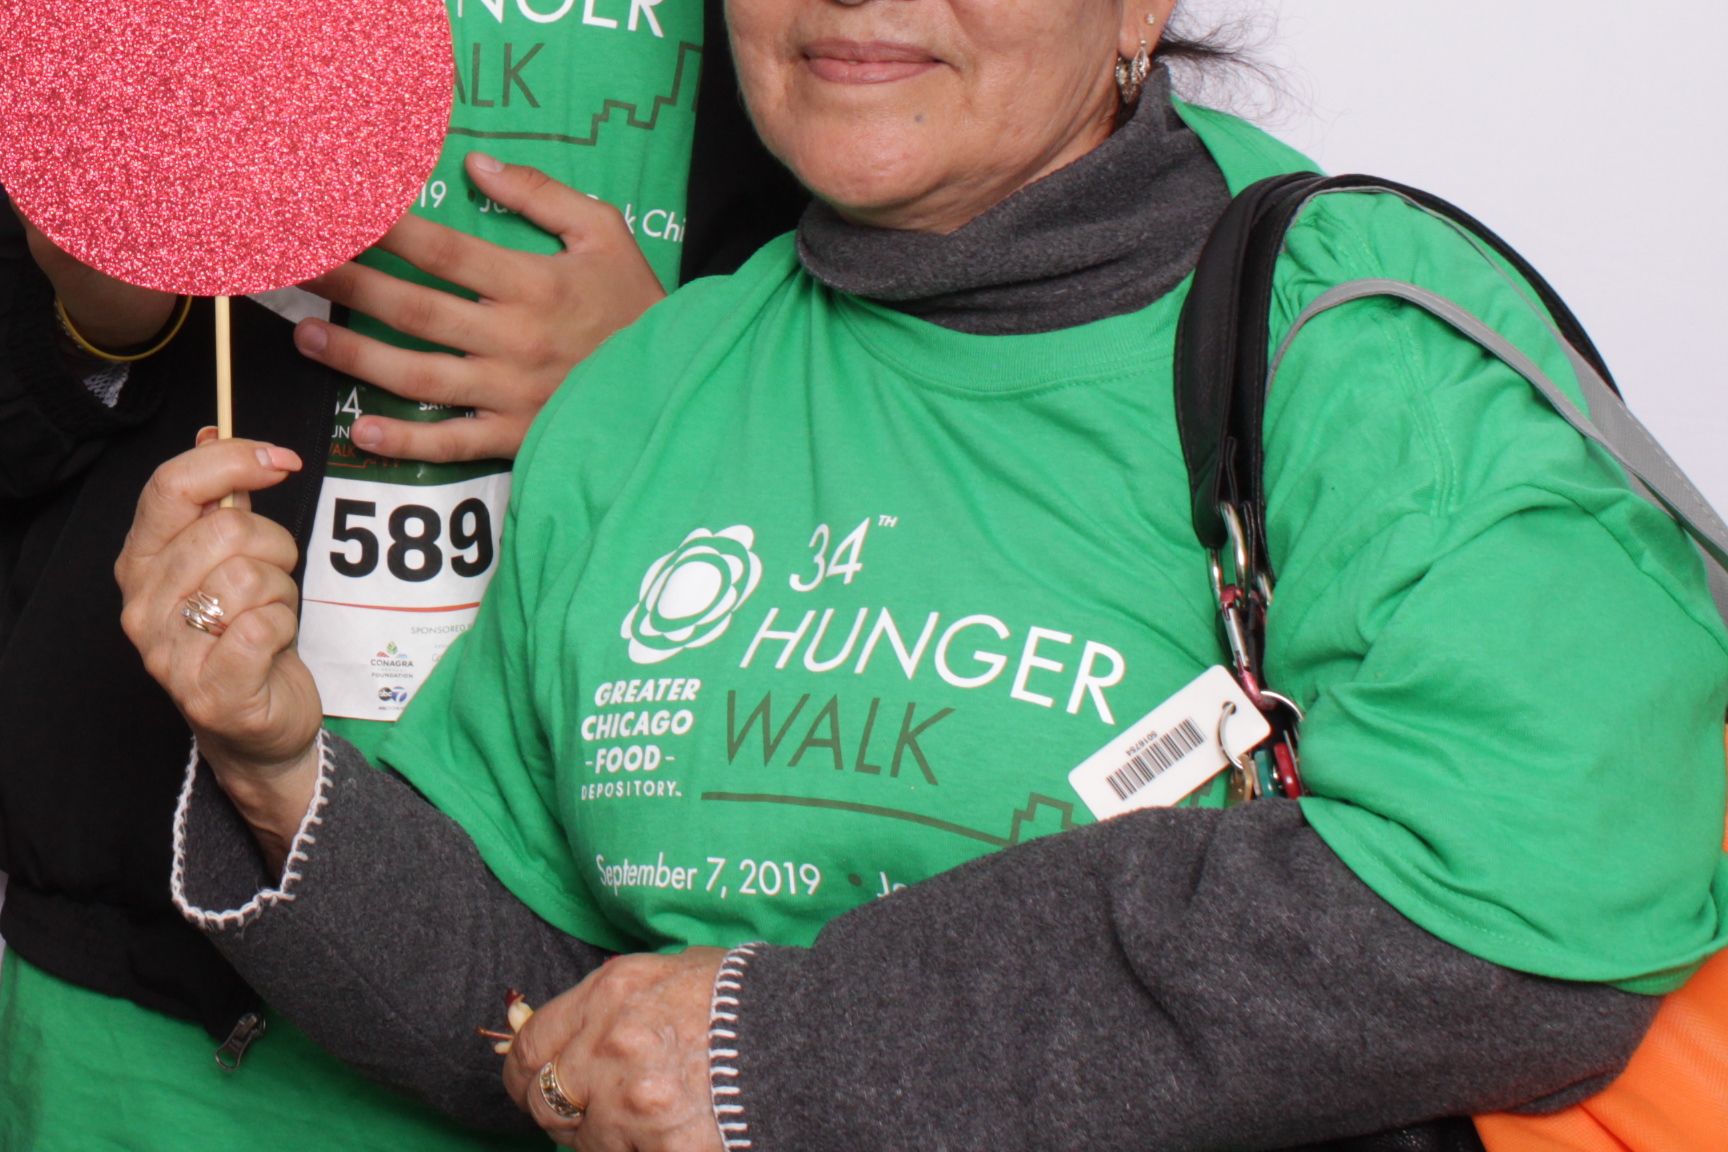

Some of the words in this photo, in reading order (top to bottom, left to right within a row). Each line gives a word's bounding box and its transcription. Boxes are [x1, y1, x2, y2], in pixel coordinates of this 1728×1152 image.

[371, 659, 413, 667] CONAGRA
[739, 606, 1126, 725] HUNGER
[594, 678, 701, 707] GREATER
[581, 709, 693, 741] CHICAGO
[727, 689, 956, 786] WALK
[596, 852, 697, 896] September
[706, 856, 727, 898] 7,
[739, 859, 821, 895] 2019
